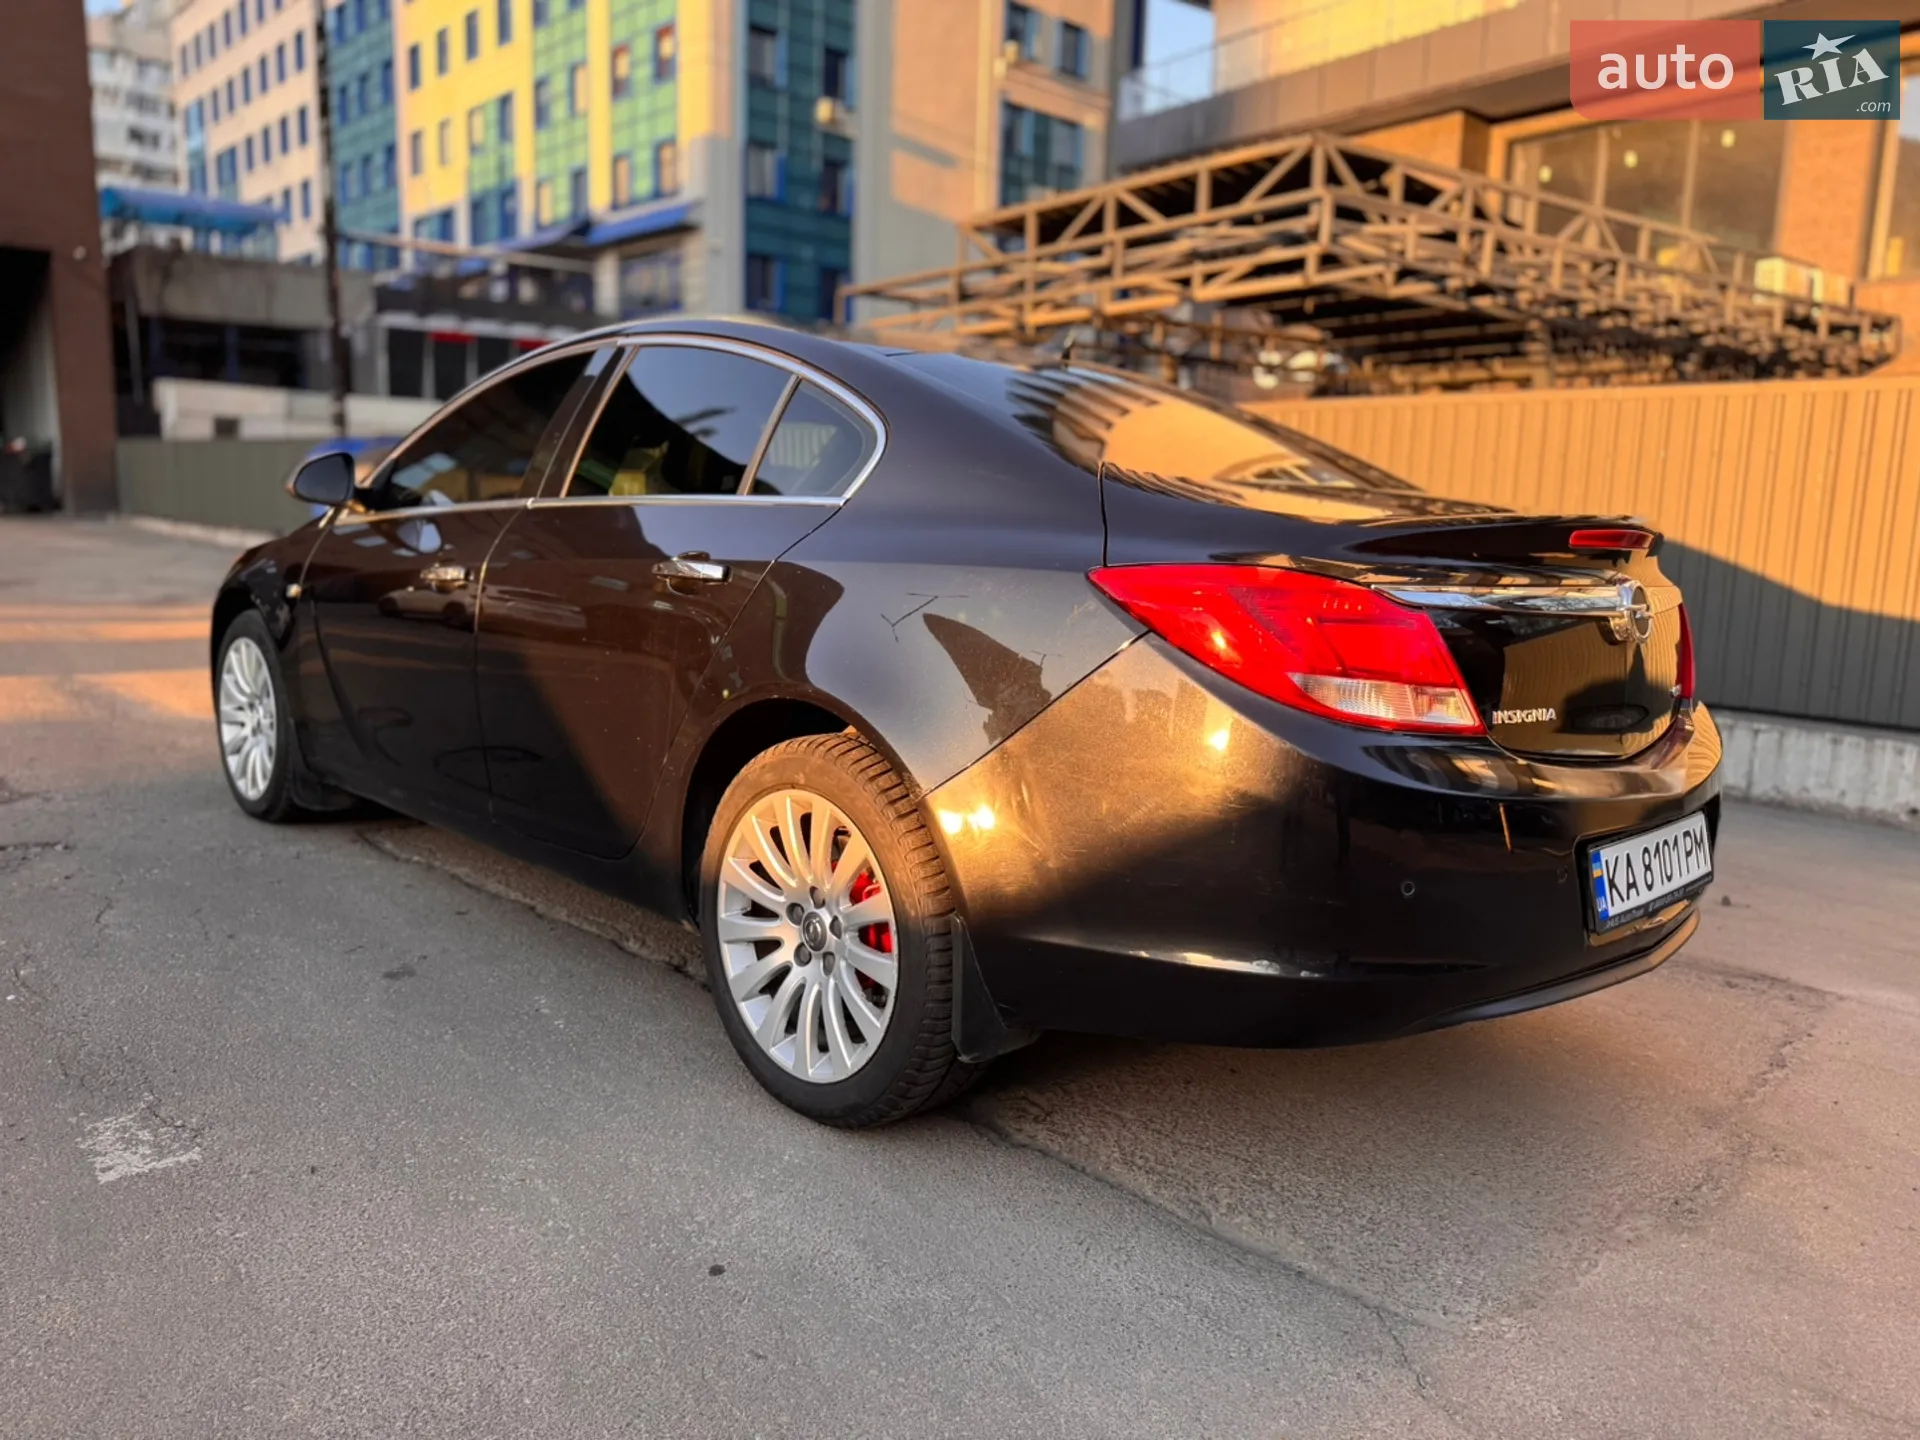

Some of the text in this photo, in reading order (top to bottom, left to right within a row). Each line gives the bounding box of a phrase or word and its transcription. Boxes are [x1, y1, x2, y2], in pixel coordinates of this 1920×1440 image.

[1492, 708, 1557, 725] INSIGNIA
[1605, 852, 1640, 907] KA
[1641, 834, 1683, 892] 8101
[1682, 824, 1707, 875] PM
